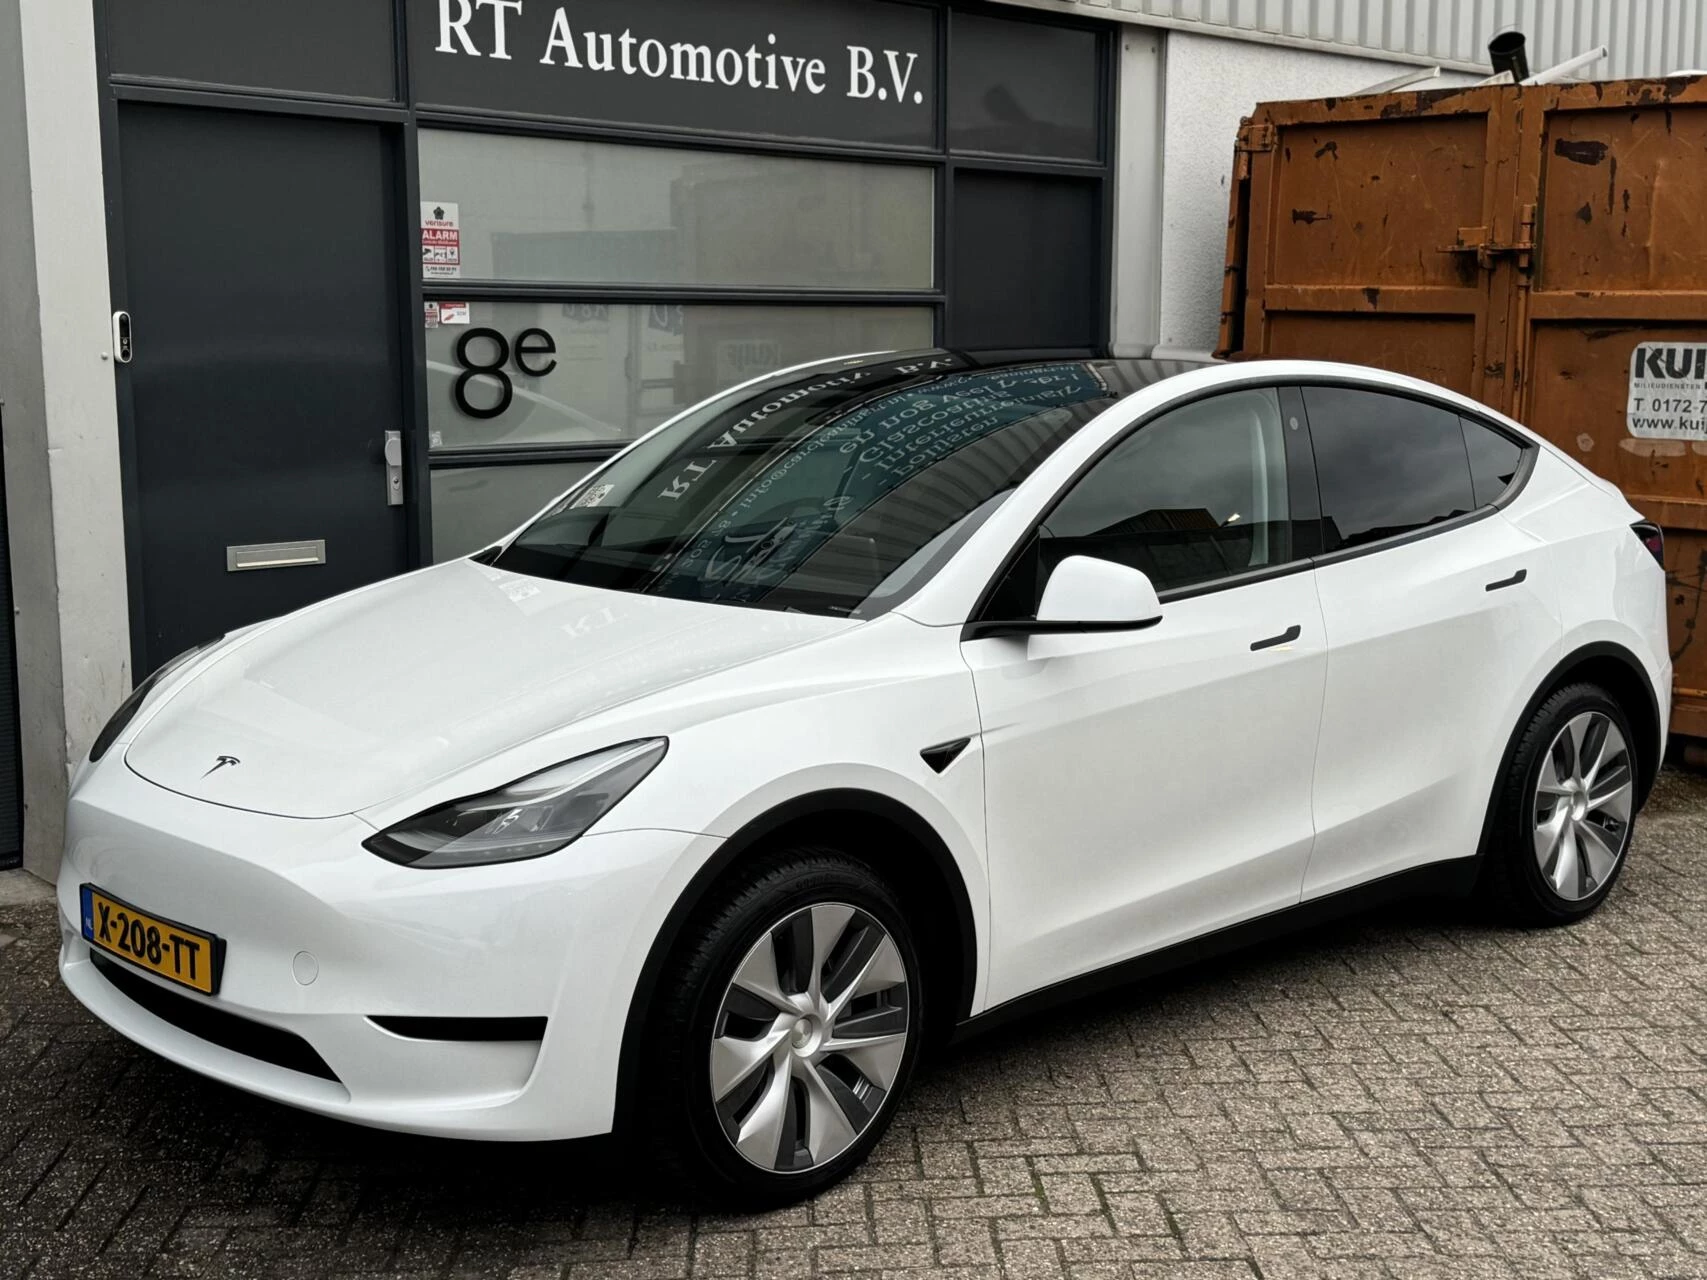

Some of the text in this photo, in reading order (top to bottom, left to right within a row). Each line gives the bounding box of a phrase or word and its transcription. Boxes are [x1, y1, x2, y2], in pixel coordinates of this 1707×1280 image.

[435, 0, 923, 104] RT Automotive B.V.
[422, 229, 458, 241] ALARM
[1633, 397, 1645, 411] T
[98, 901, 200, 980] X-208-TT
